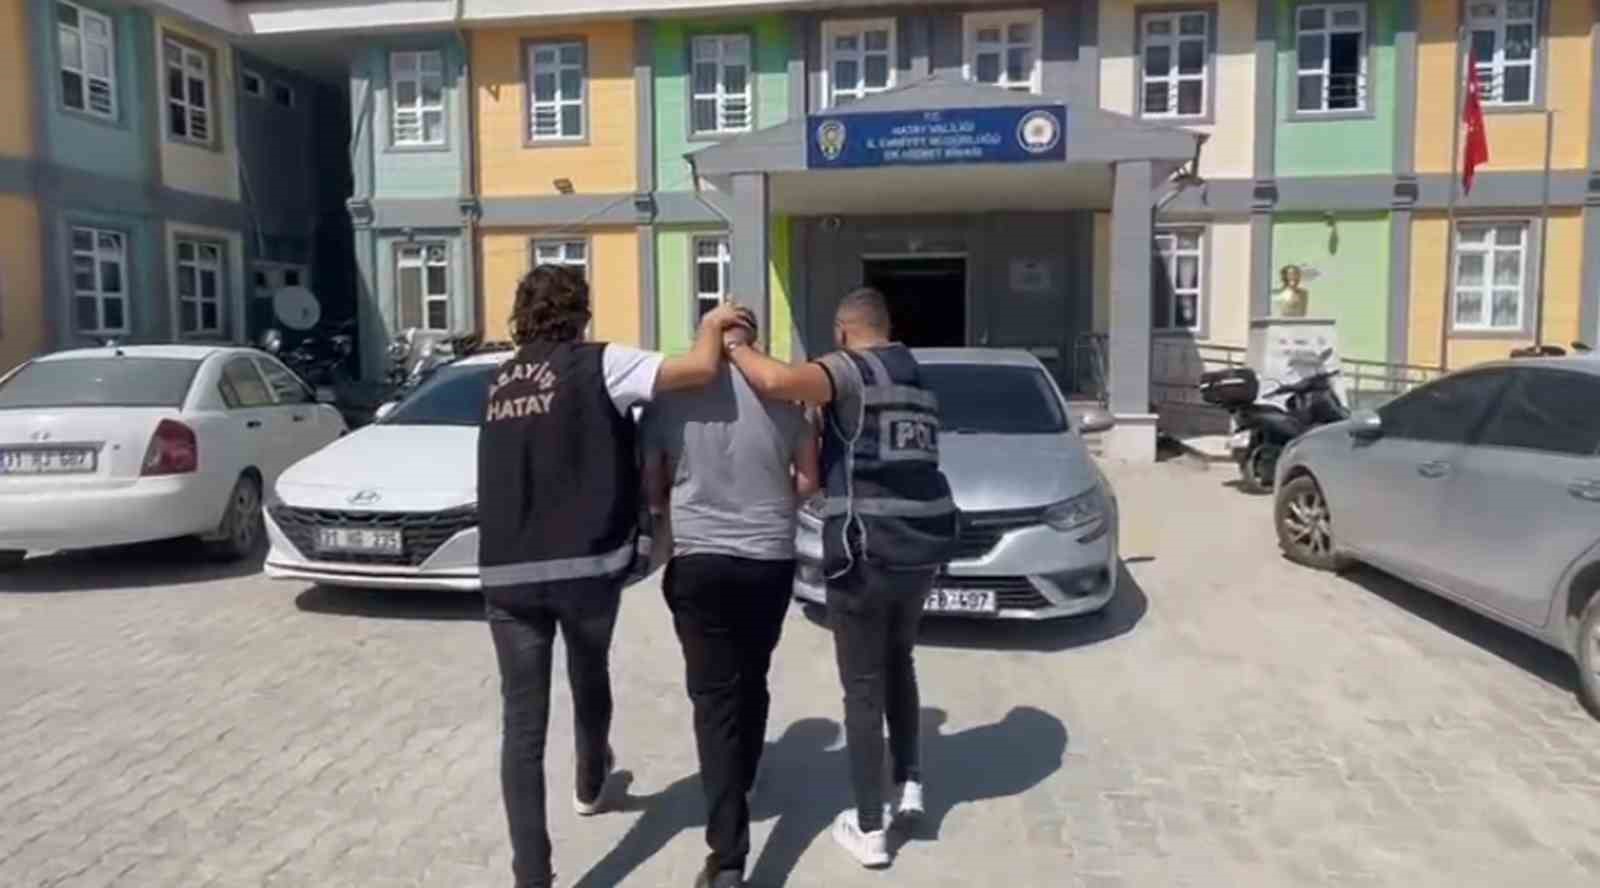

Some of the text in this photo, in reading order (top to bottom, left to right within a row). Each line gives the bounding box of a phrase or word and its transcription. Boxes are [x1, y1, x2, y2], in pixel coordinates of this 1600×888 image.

[892, 124, 927, 135] HATAY
[486, 391, 555, 422] HATAY
[896, 421, 934, 448] POL
